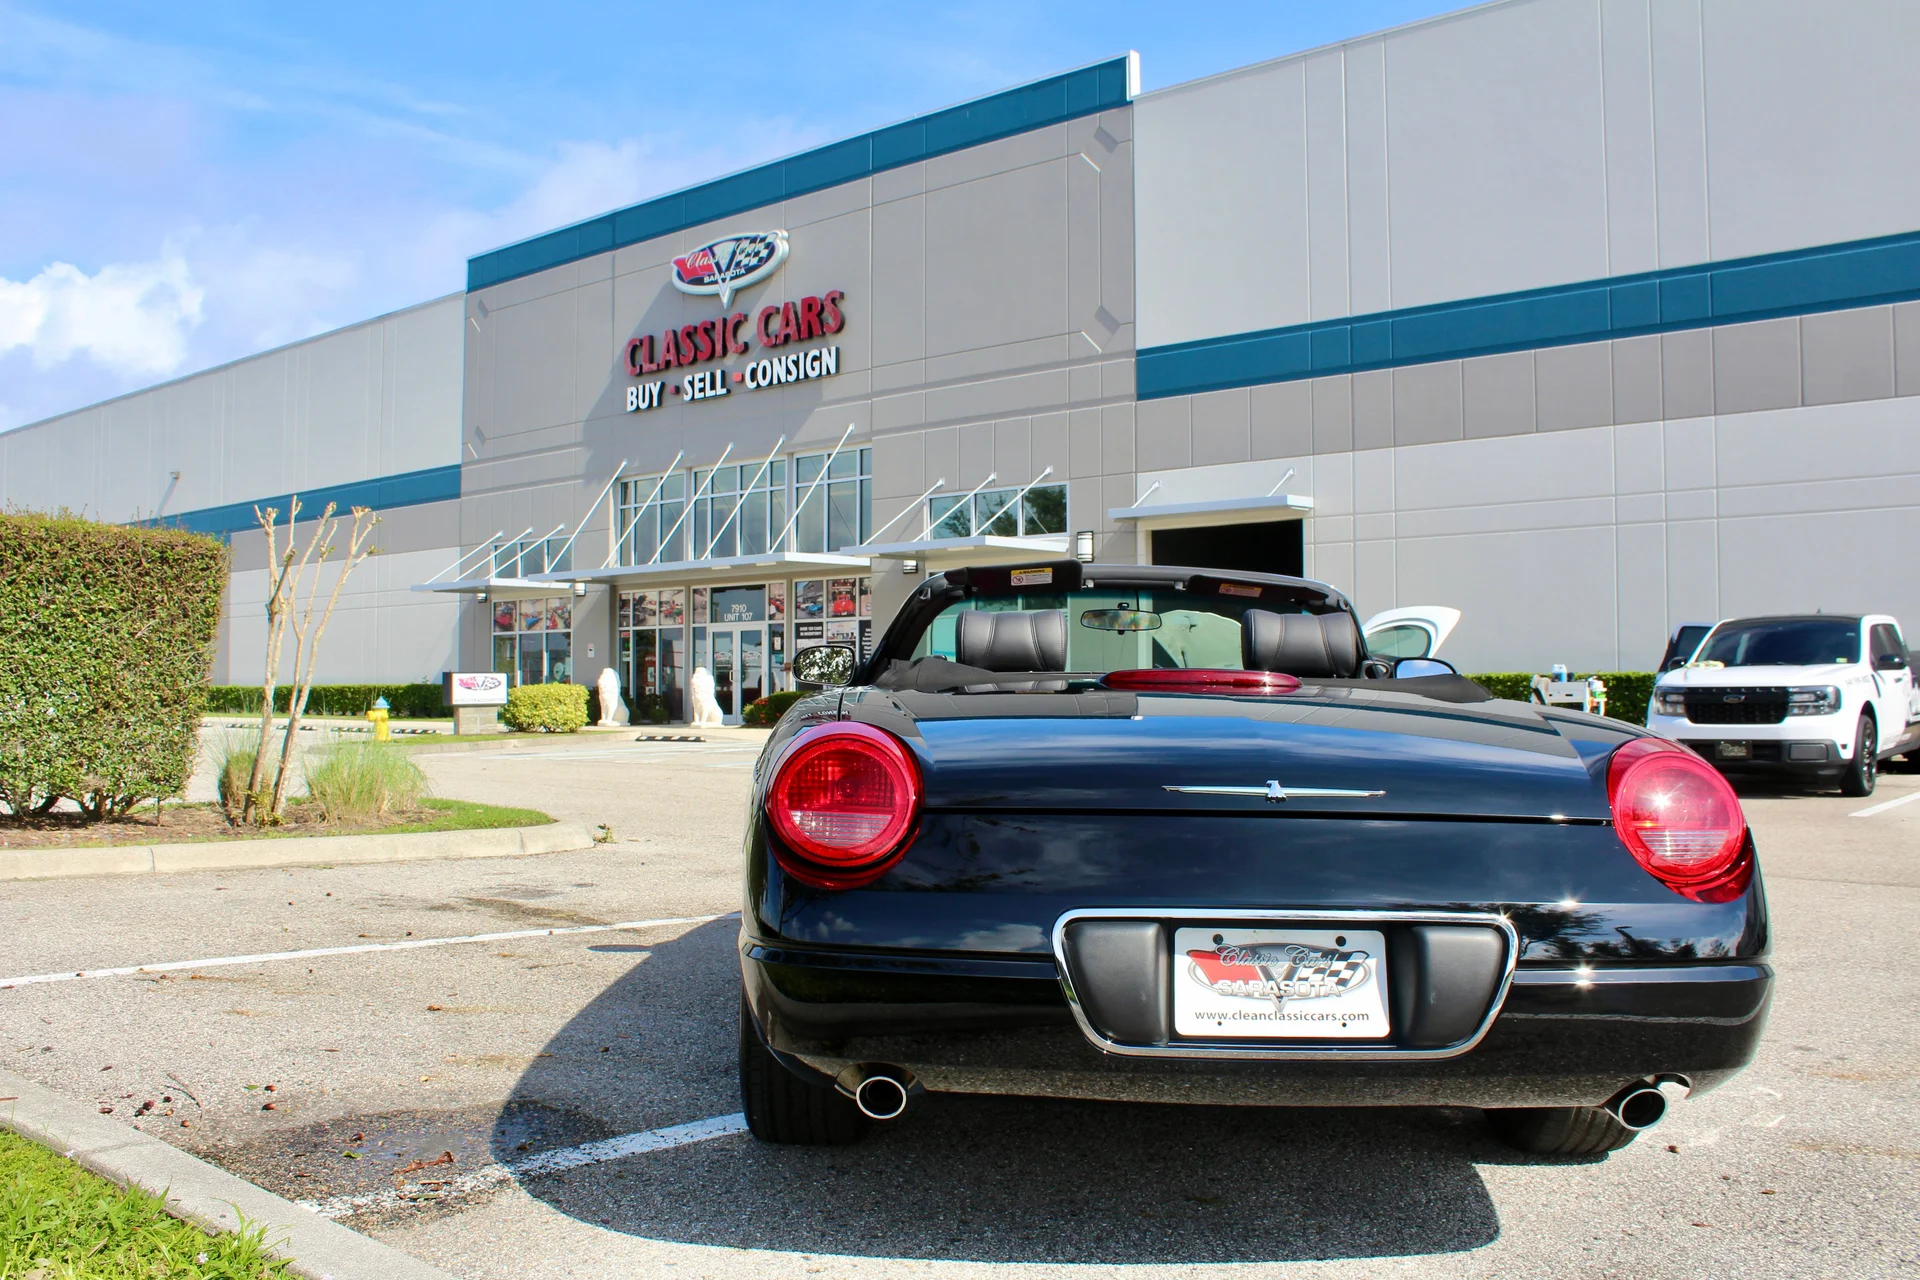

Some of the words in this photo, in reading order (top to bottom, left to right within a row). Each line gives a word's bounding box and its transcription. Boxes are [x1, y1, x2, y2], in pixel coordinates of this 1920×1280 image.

[623, 312, 748, 377] CLASSIC
[756, 290, 845, 348] CARS
[626, 381, 665, 412] BUY
[683, 369, 730, 401] SELL
[745, 346, 840, 389] CONSIGN
[724, 613, 740, 622] UNIT
[741, 612, 753, 621] 107
[731, 604, 747, 613] 7910
[1215, 944, 1279, 967] Classic
[1284, 944, 1337, 967] Cars
[1217, 979, 1342, 997] SARASOTA
[1195, 1009, 1370, 1022] www.cleanclassiccars.com
